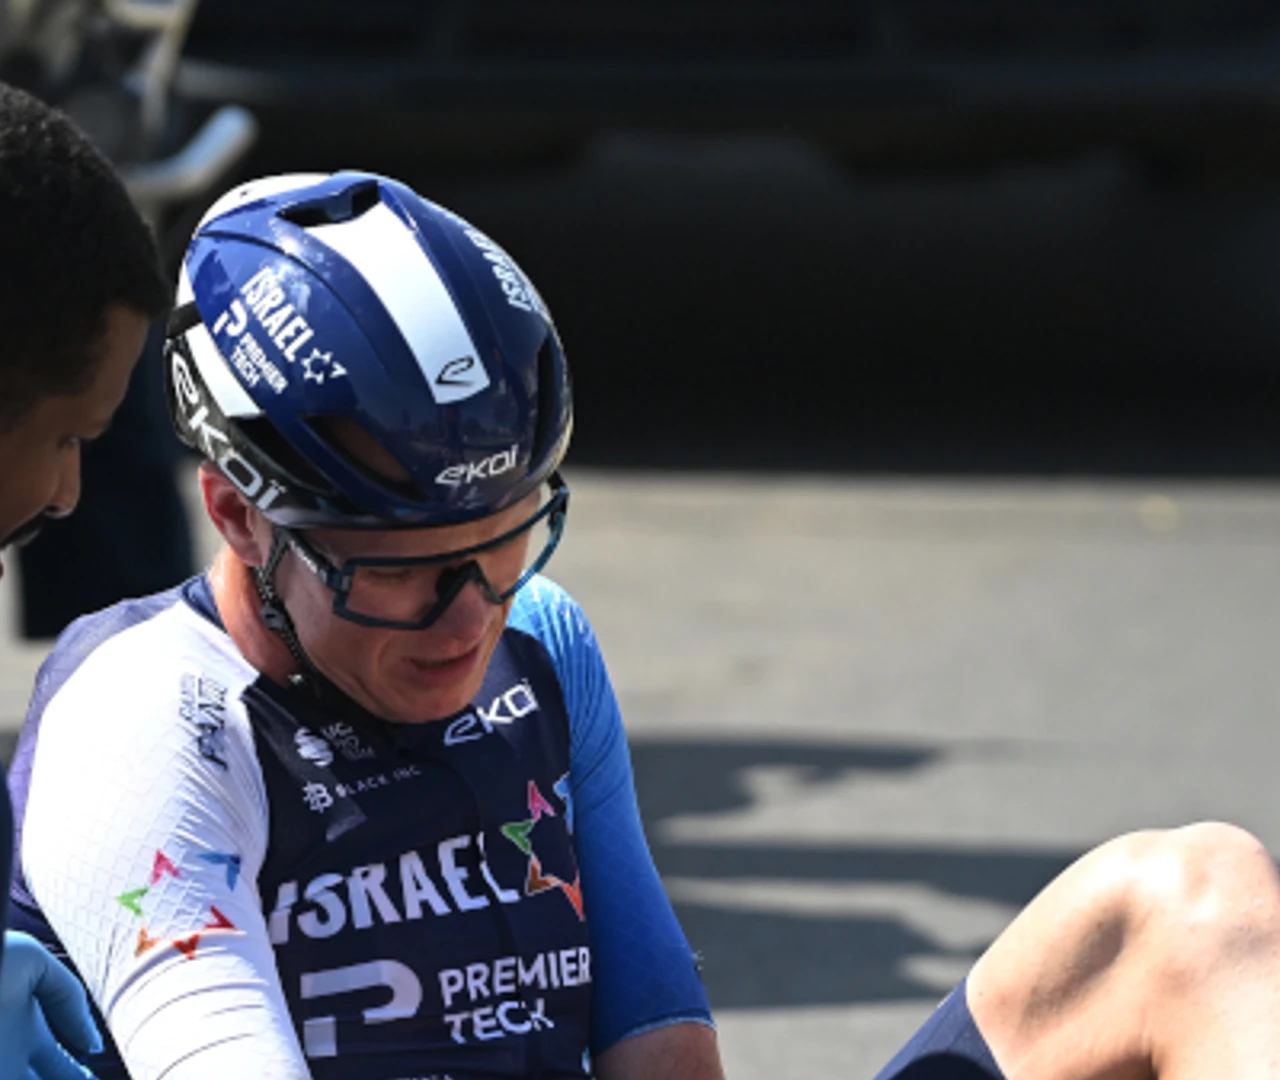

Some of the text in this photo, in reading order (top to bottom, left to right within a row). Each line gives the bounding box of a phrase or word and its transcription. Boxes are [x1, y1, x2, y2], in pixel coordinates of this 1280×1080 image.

[240, 265, 314, 362] ISRAEL
[267, 831, 519, 945] ISRAEL
[438, 946, 592, 1008] PREMIER
